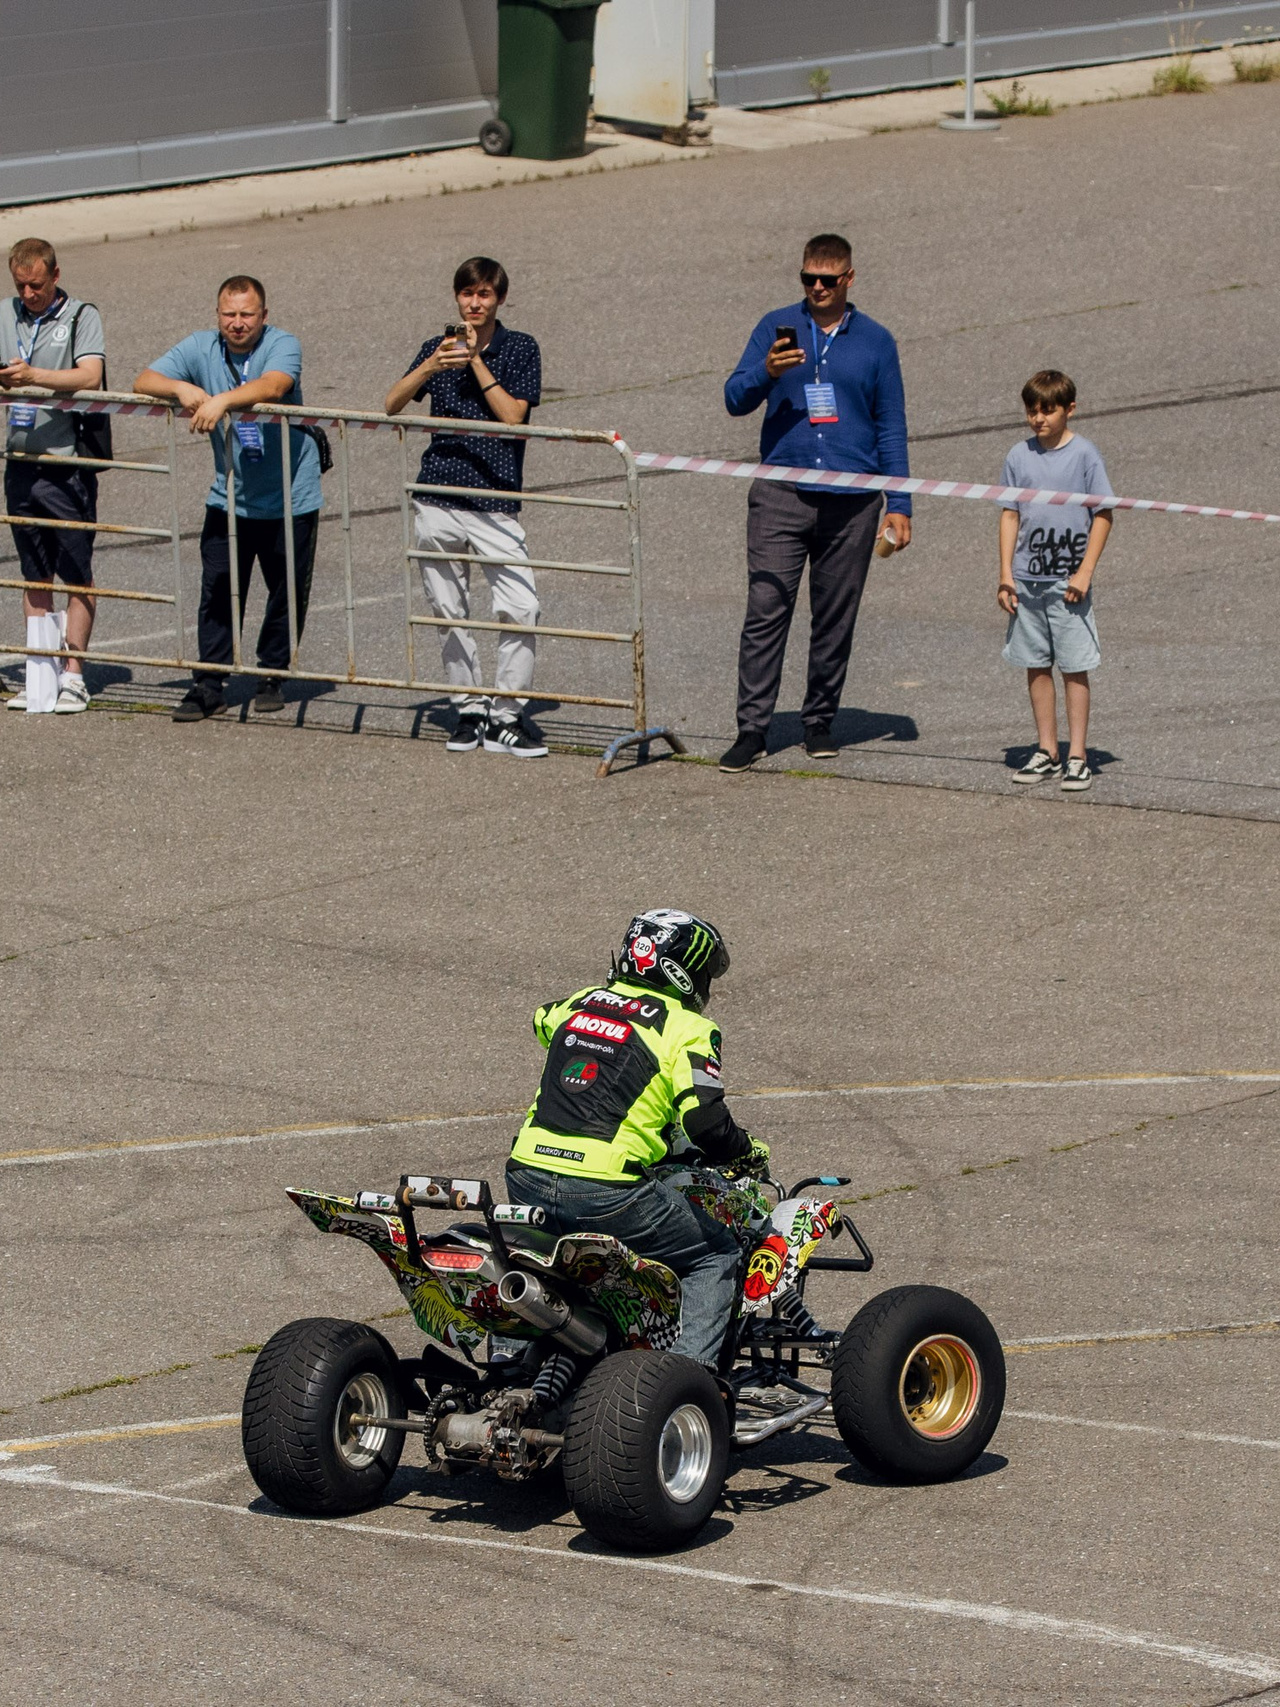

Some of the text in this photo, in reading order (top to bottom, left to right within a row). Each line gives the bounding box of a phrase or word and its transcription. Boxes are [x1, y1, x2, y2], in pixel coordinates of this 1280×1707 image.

[1029, 527, 1088, 554] GAME
[634, 941, 651, 953] 320
[665, 963, 690, 990] HJC
[570, 1015, 627, 1040] MOTUL
[562, 1061, 598, 1080] AG
[565, 1077, 587, 1085] TEAM
[536, 1145, 584, 1161] MARKOV MX RU
